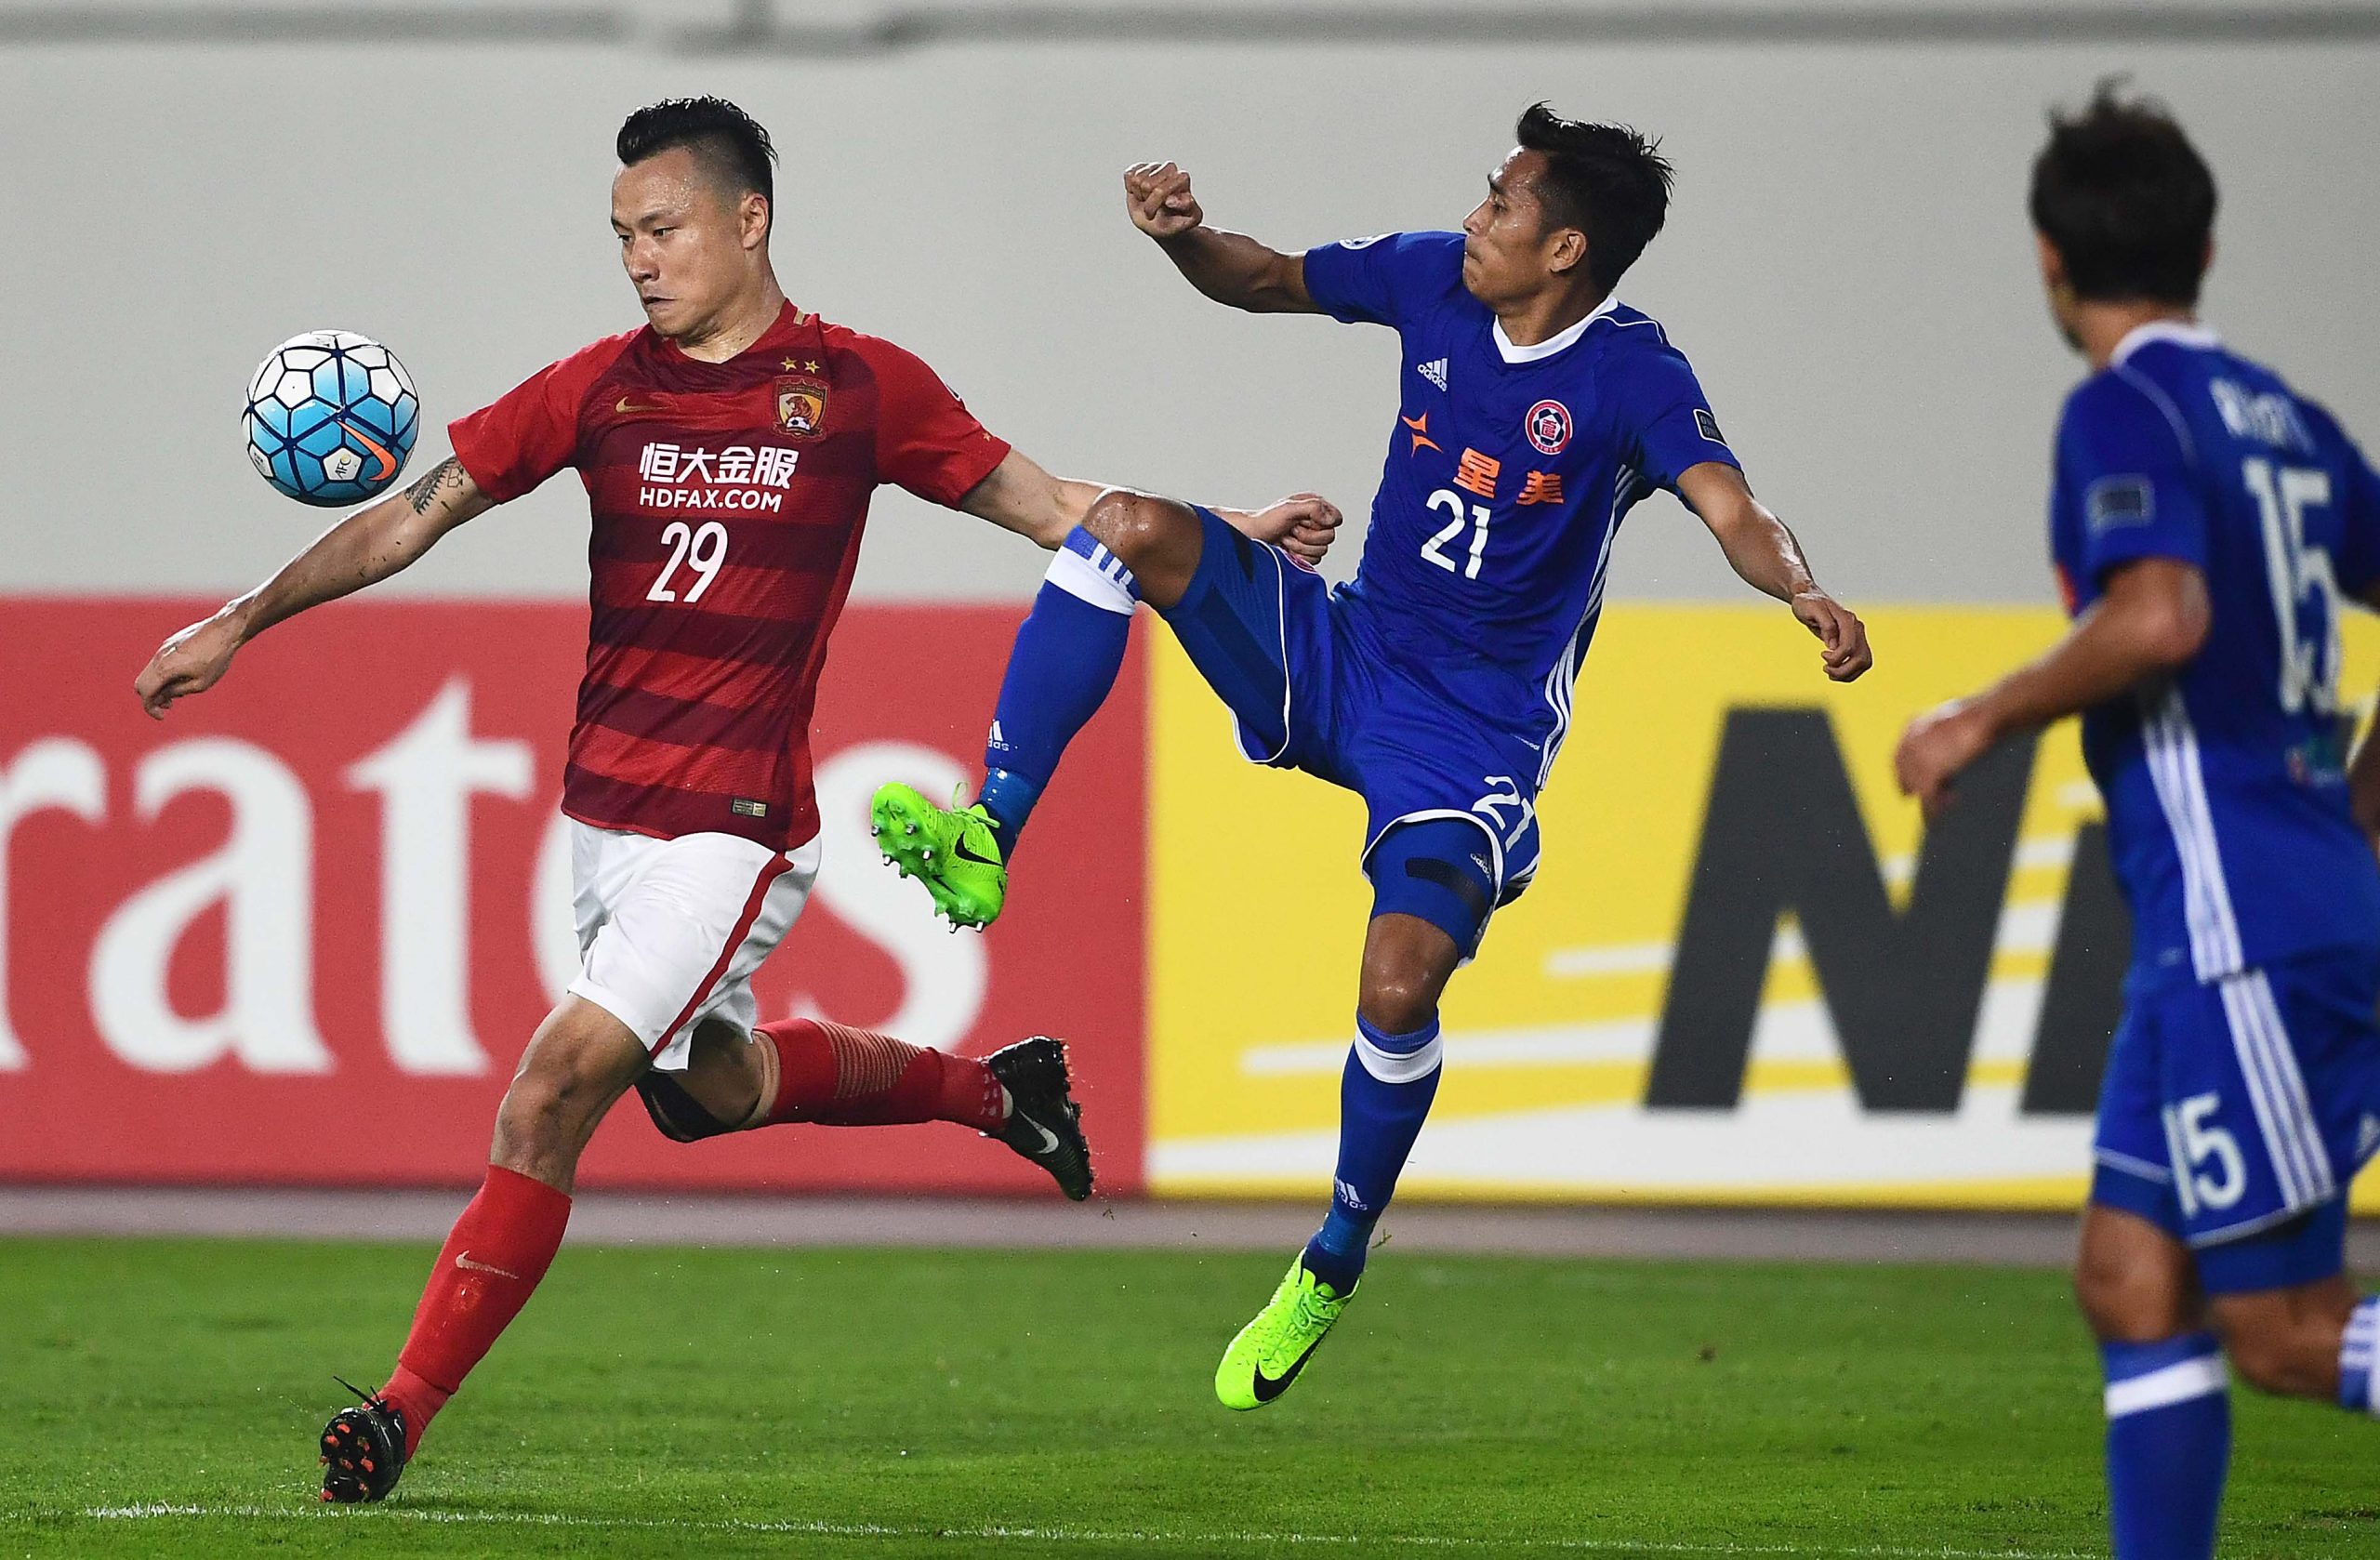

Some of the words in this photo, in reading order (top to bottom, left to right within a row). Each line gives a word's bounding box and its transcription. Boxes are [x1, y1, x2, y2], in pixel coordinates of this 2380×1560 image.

[639, 443, 800, 489] 恒大金服
[640, 486, 782, 512] HDFAX.COM
[646, 522, 728, 602] 29
[1421, 489, 1491, 579] 21
[2242, 459, 2343, 714] 15
[1472, 776, 1534, 853] 21
[2162, 1091, 2247, 1220] 15
